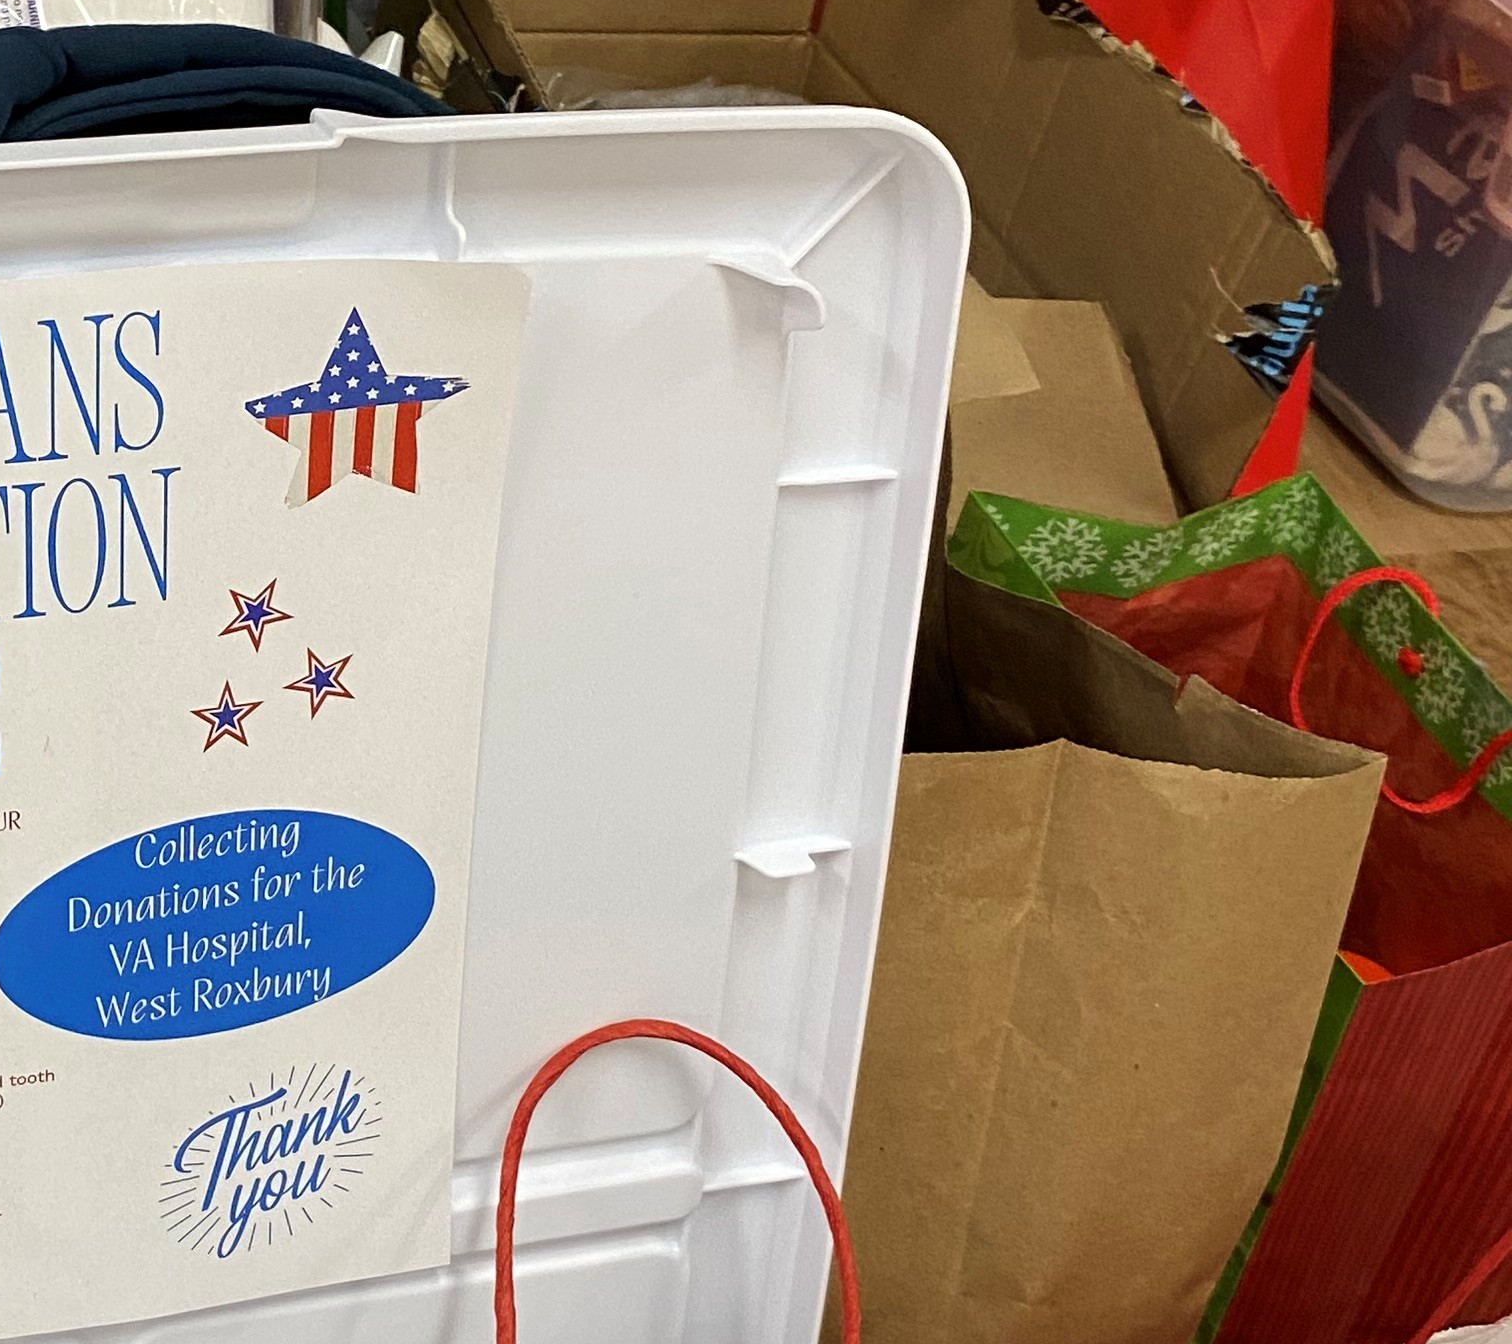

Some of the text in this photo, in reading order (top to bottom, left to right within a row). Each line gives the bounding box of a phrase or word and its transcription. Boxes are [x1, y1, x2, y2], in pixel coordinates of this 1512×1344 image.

[134, 819, 301, 870] Collecting
[67, 855, 366, 933] Donations for the
[108, 910, 313, 977] VA Hospital,
[95, 964, 333, 1029] West Roxbury
[9, 1069, 56, 1088] tooth
[173, 1068, 368, 1212] Thank
[216, 1153, 332, 1259] you
